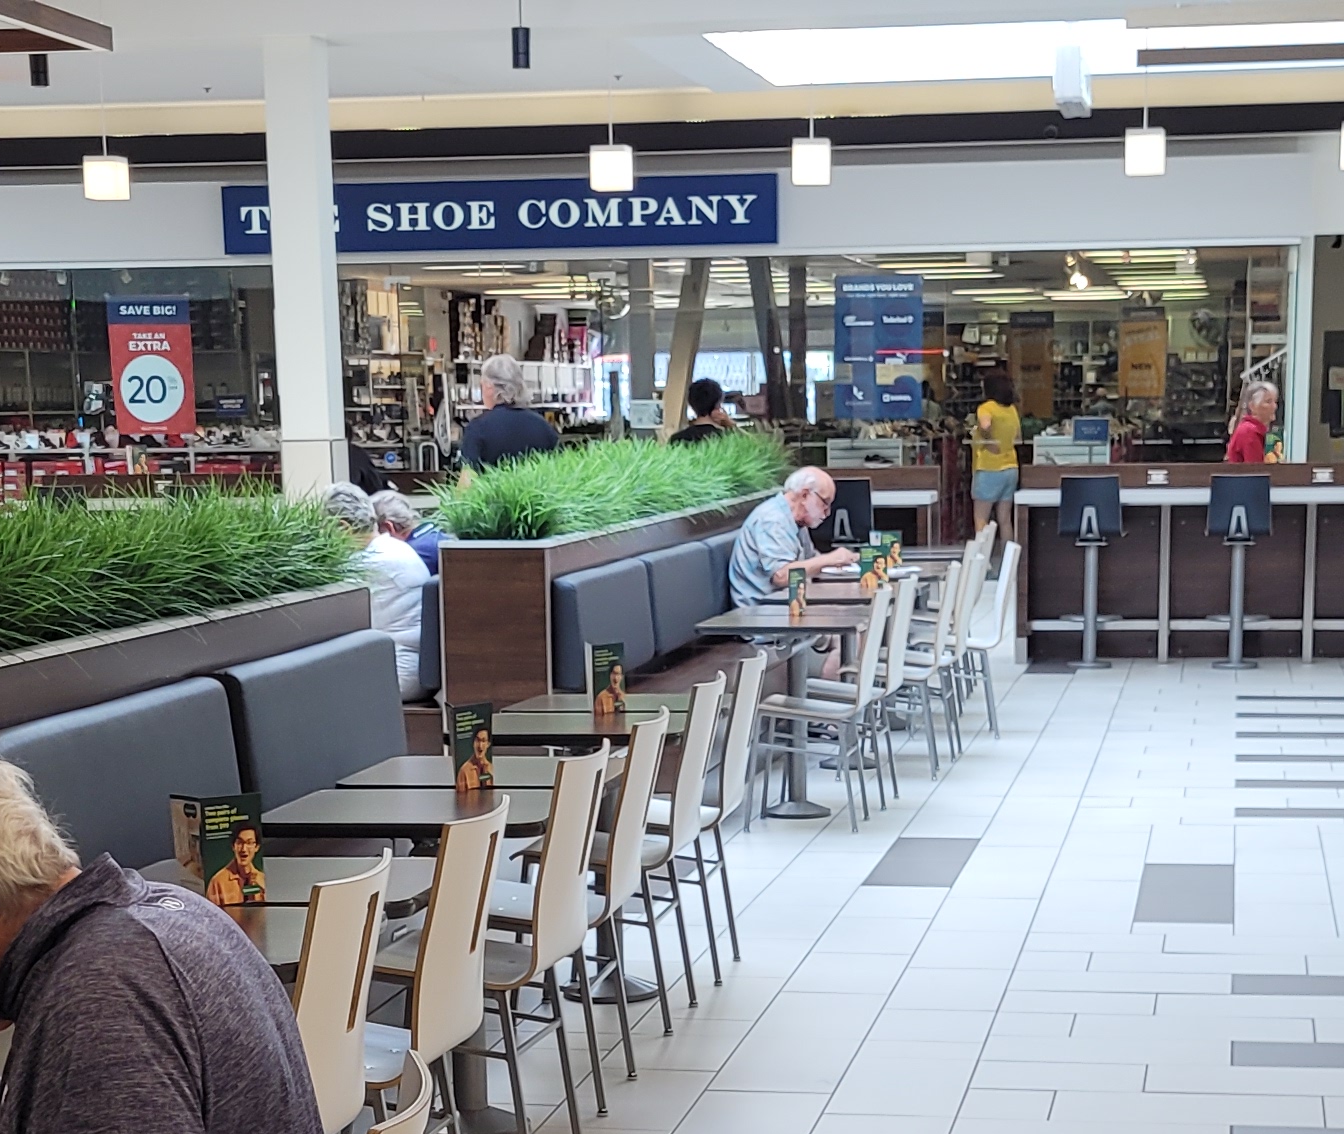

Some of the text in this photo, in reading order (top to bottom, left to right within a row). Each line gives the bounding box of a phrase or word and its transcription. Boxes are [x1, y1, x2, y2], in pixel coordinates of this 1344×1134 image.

[366, 201, 496, 232] SHOE
[517, 194, 758, 229] COMPANY
[119, 305, 177, 316] SAVE BIG!
[128, 341, 171, 351] EXTRA
